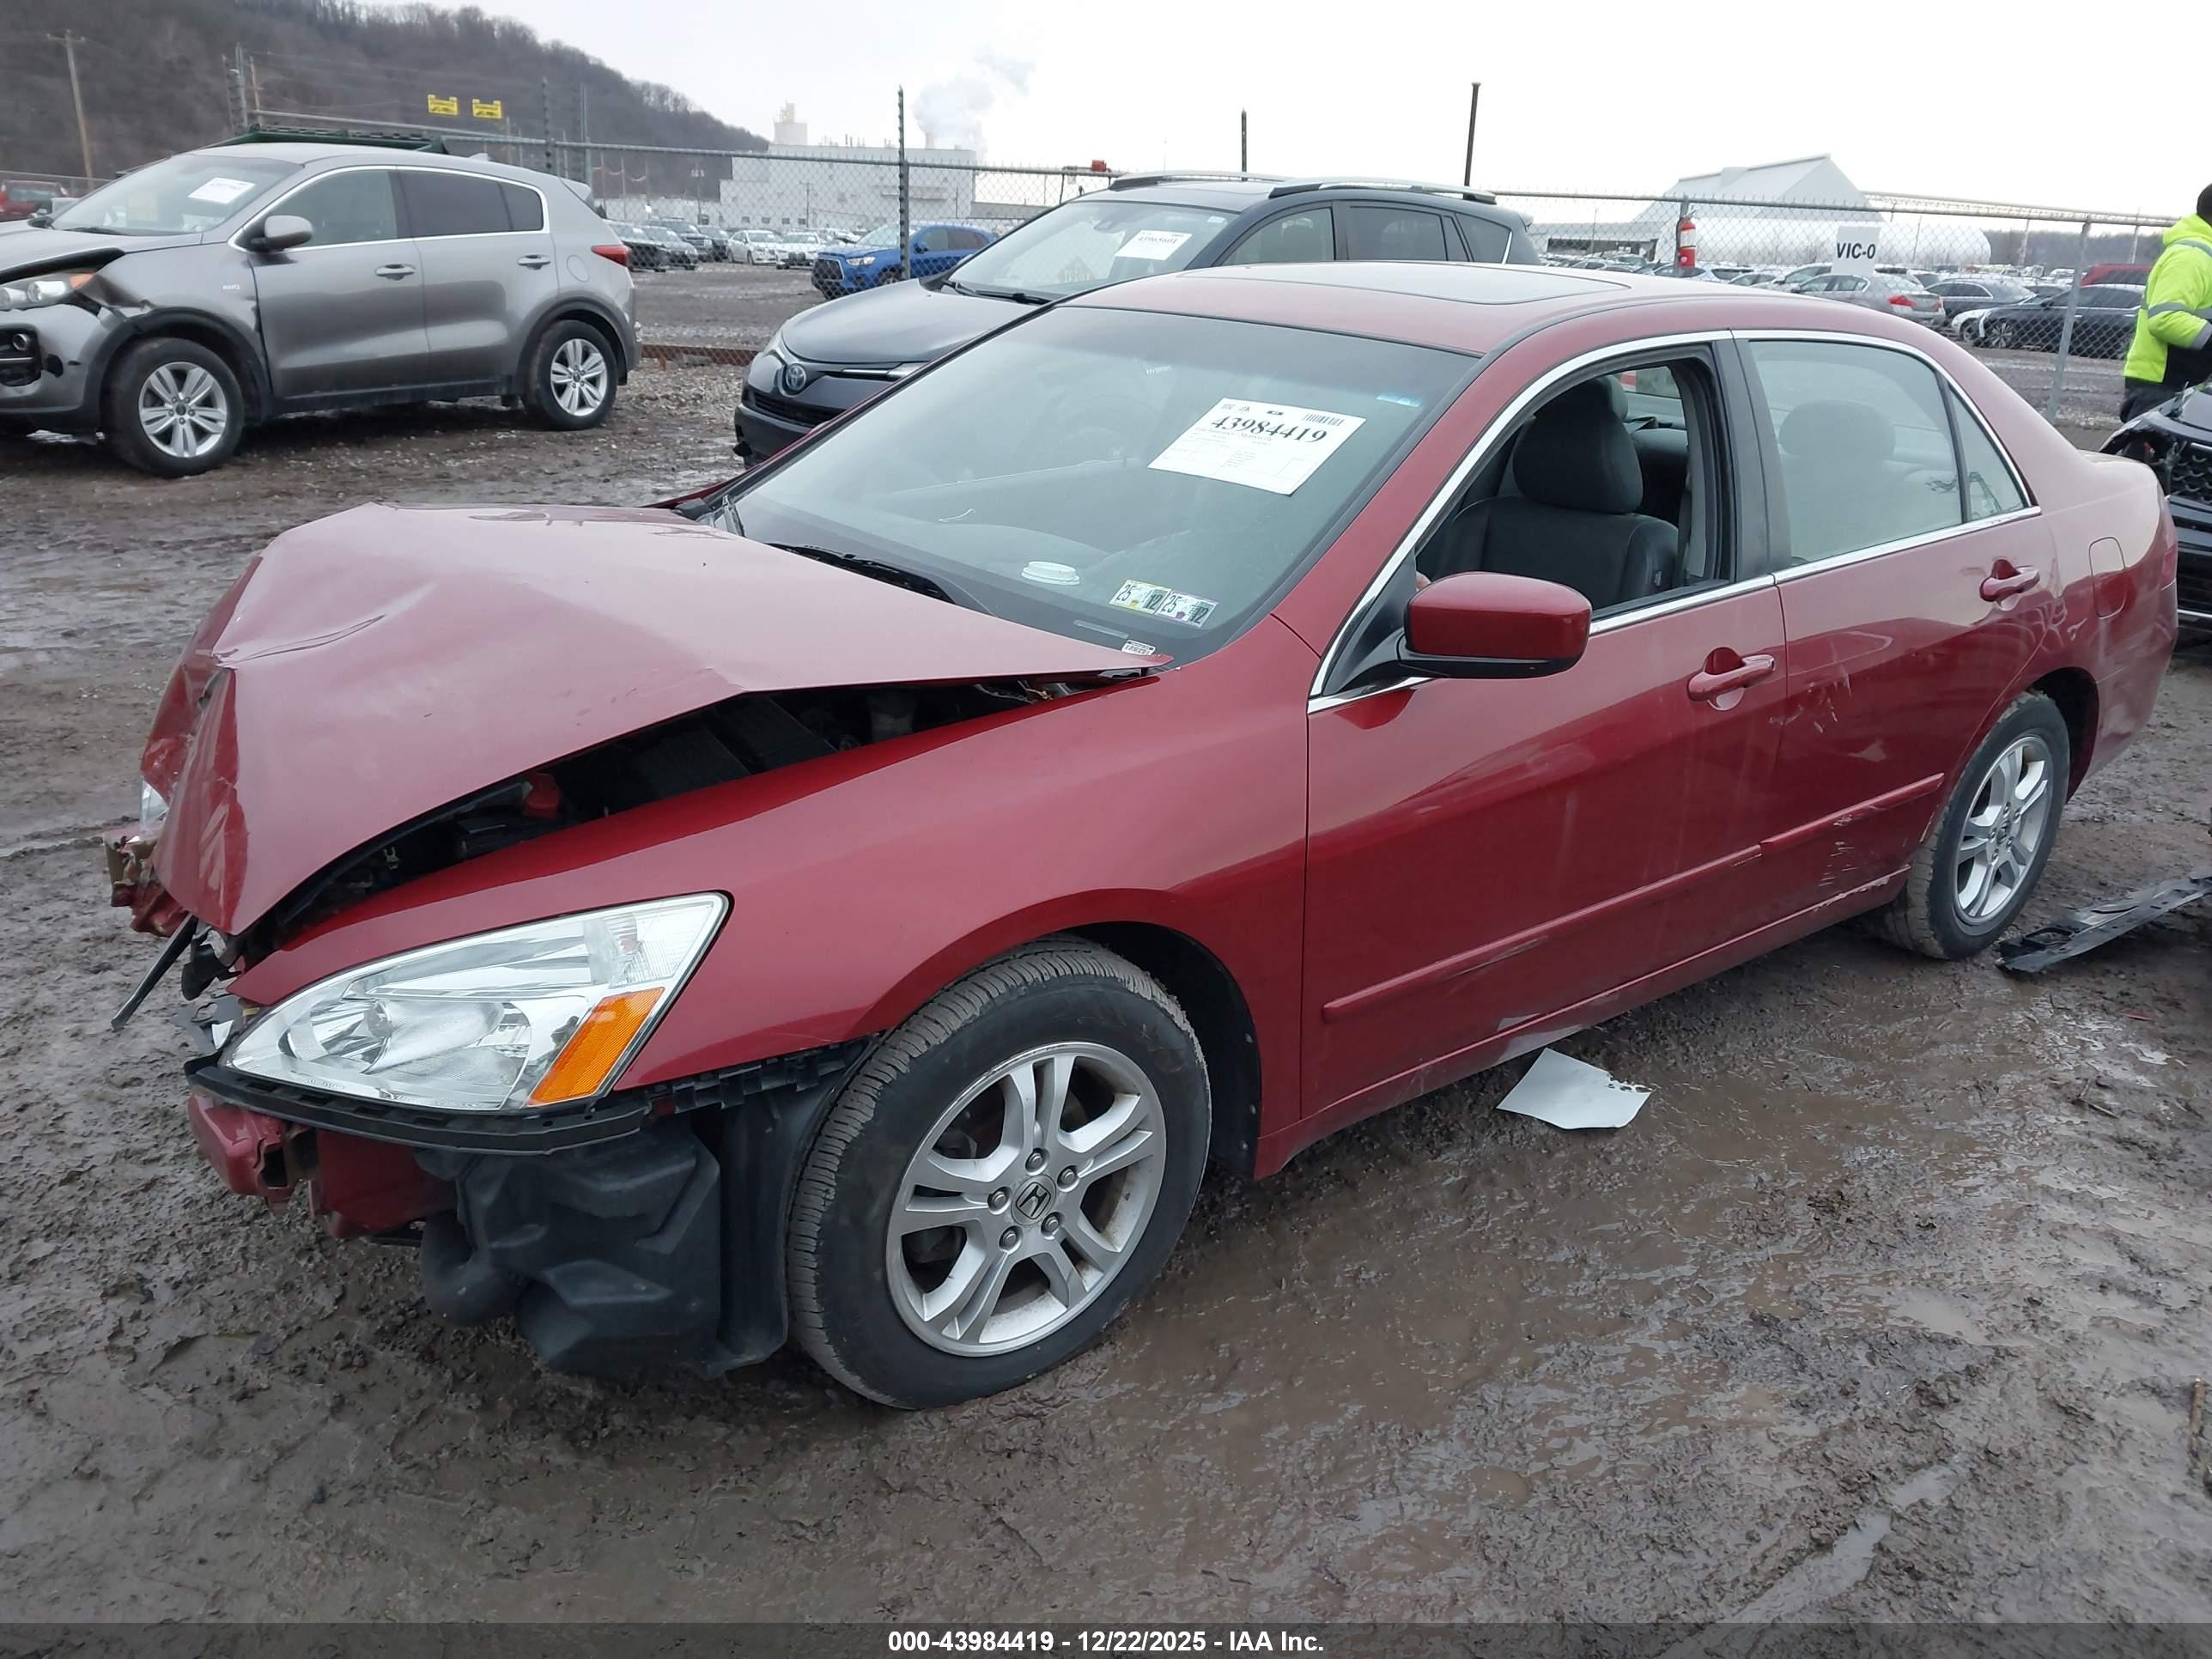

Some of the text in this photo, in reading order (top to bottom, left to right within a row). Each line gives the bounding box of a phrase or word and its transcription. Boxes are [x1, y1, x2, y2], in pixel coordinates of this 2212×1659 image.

[1211, 416, 1328, 443] 43984419
[1116, 584, 1163, 611] 25 12
[1161, 594, 1182, 613] 25
